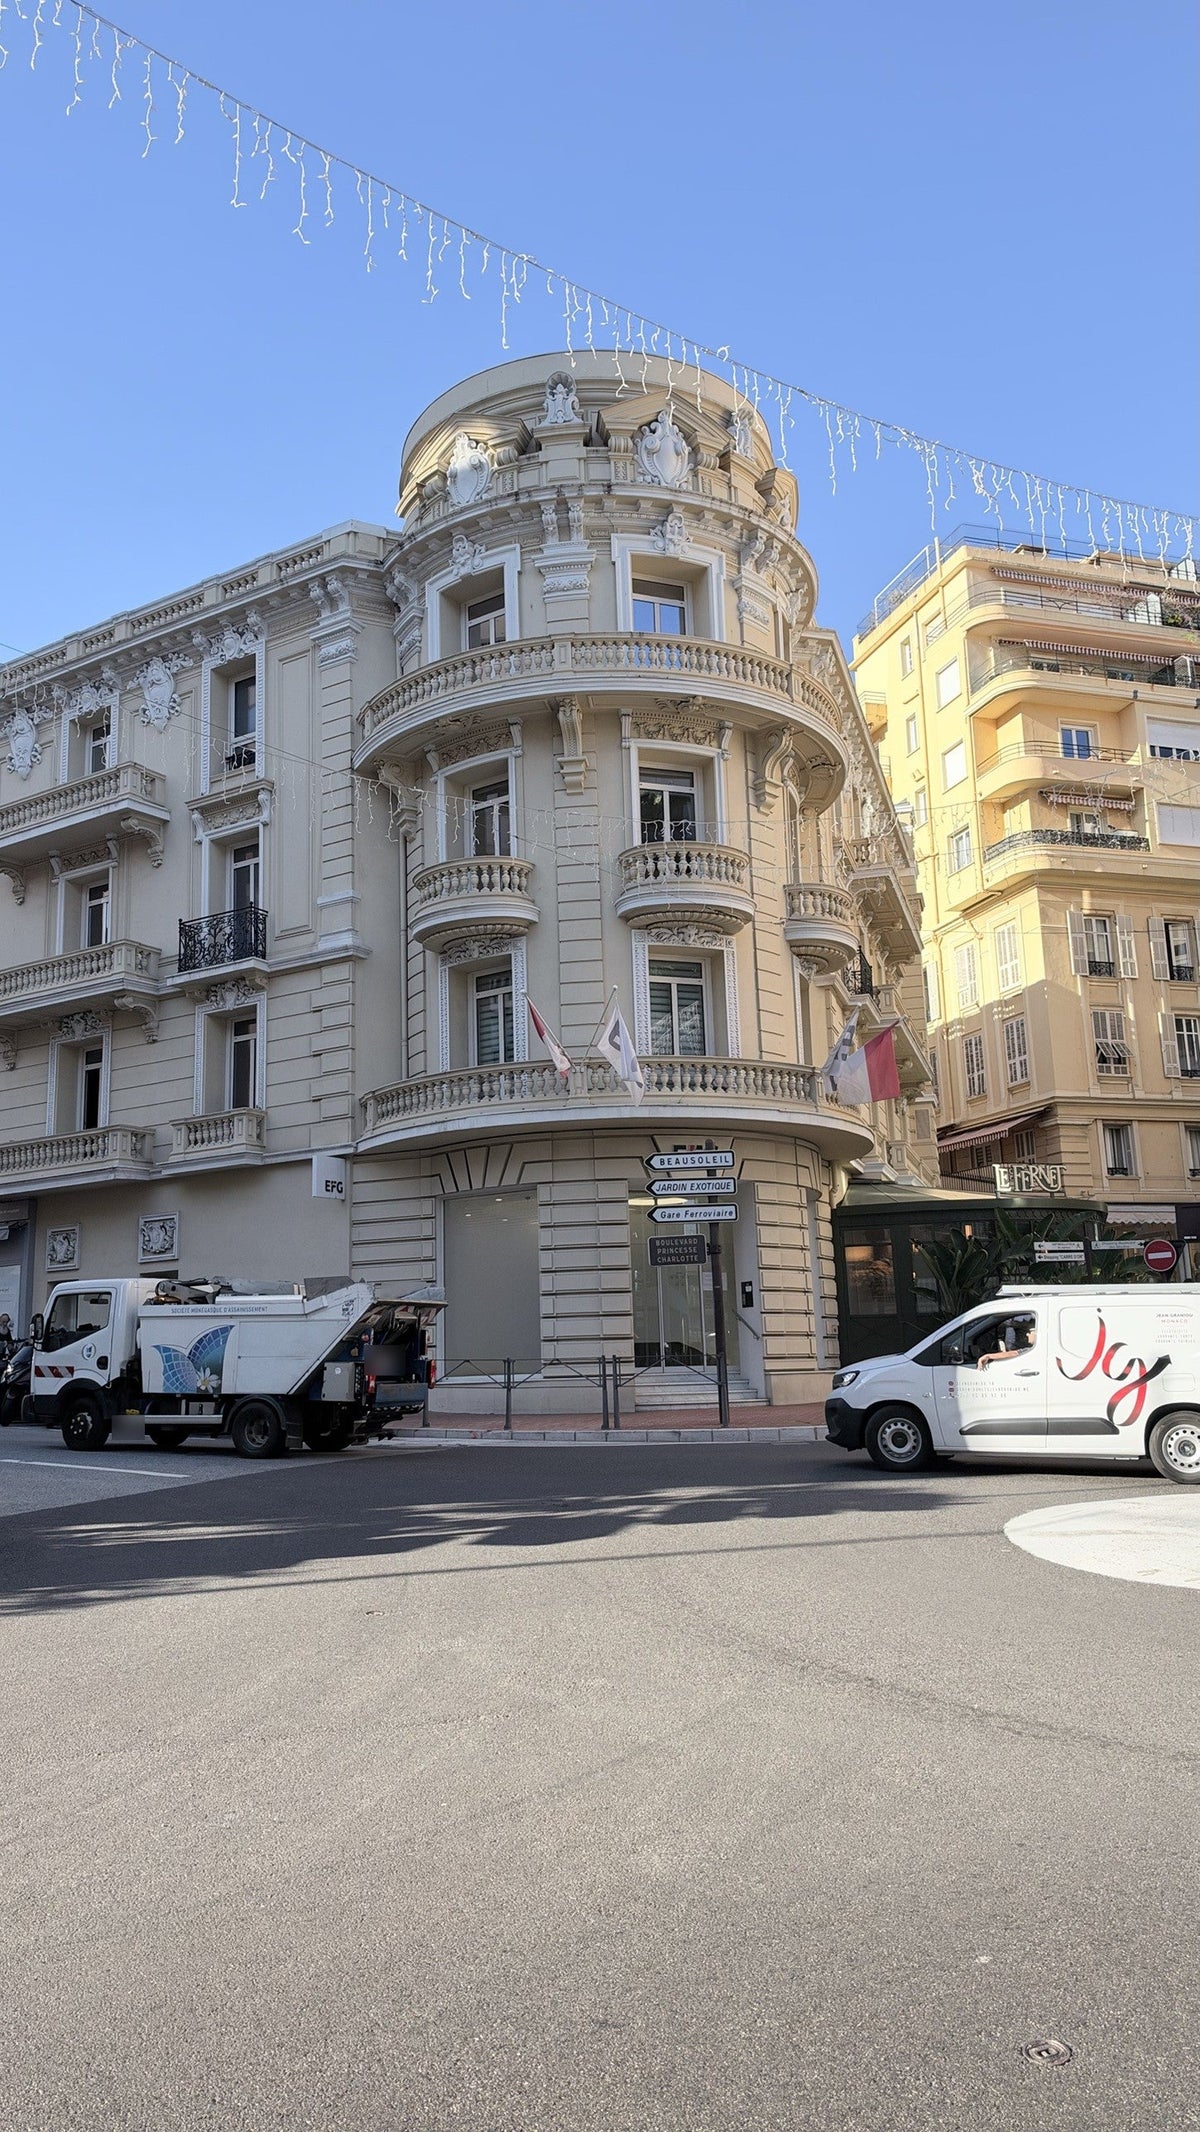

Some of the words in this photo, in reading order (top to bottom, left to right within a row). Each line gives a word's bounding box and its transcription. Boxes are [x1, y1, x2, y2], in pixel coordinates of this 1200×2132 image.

[659, 1155, 730, 1166] BEAUSOLEIL
[992, 1163, 1012, 1191] LE
[324, 1179, 344, 1194] EFG
[655, 1183, 687, 1192] JARDIN
[689, 1181, 732, 1191] EXOTIQUE
[660, 1210, 681, 1219] Gare
[684, 1208, 734, 1219] Ferroviaire
[655, 1238, 698, 1246] BOULEVARD
[657, 1246, 698, 1255] PRINCESSE
[657, 1255, 698, 1263] CHARLOTTE
